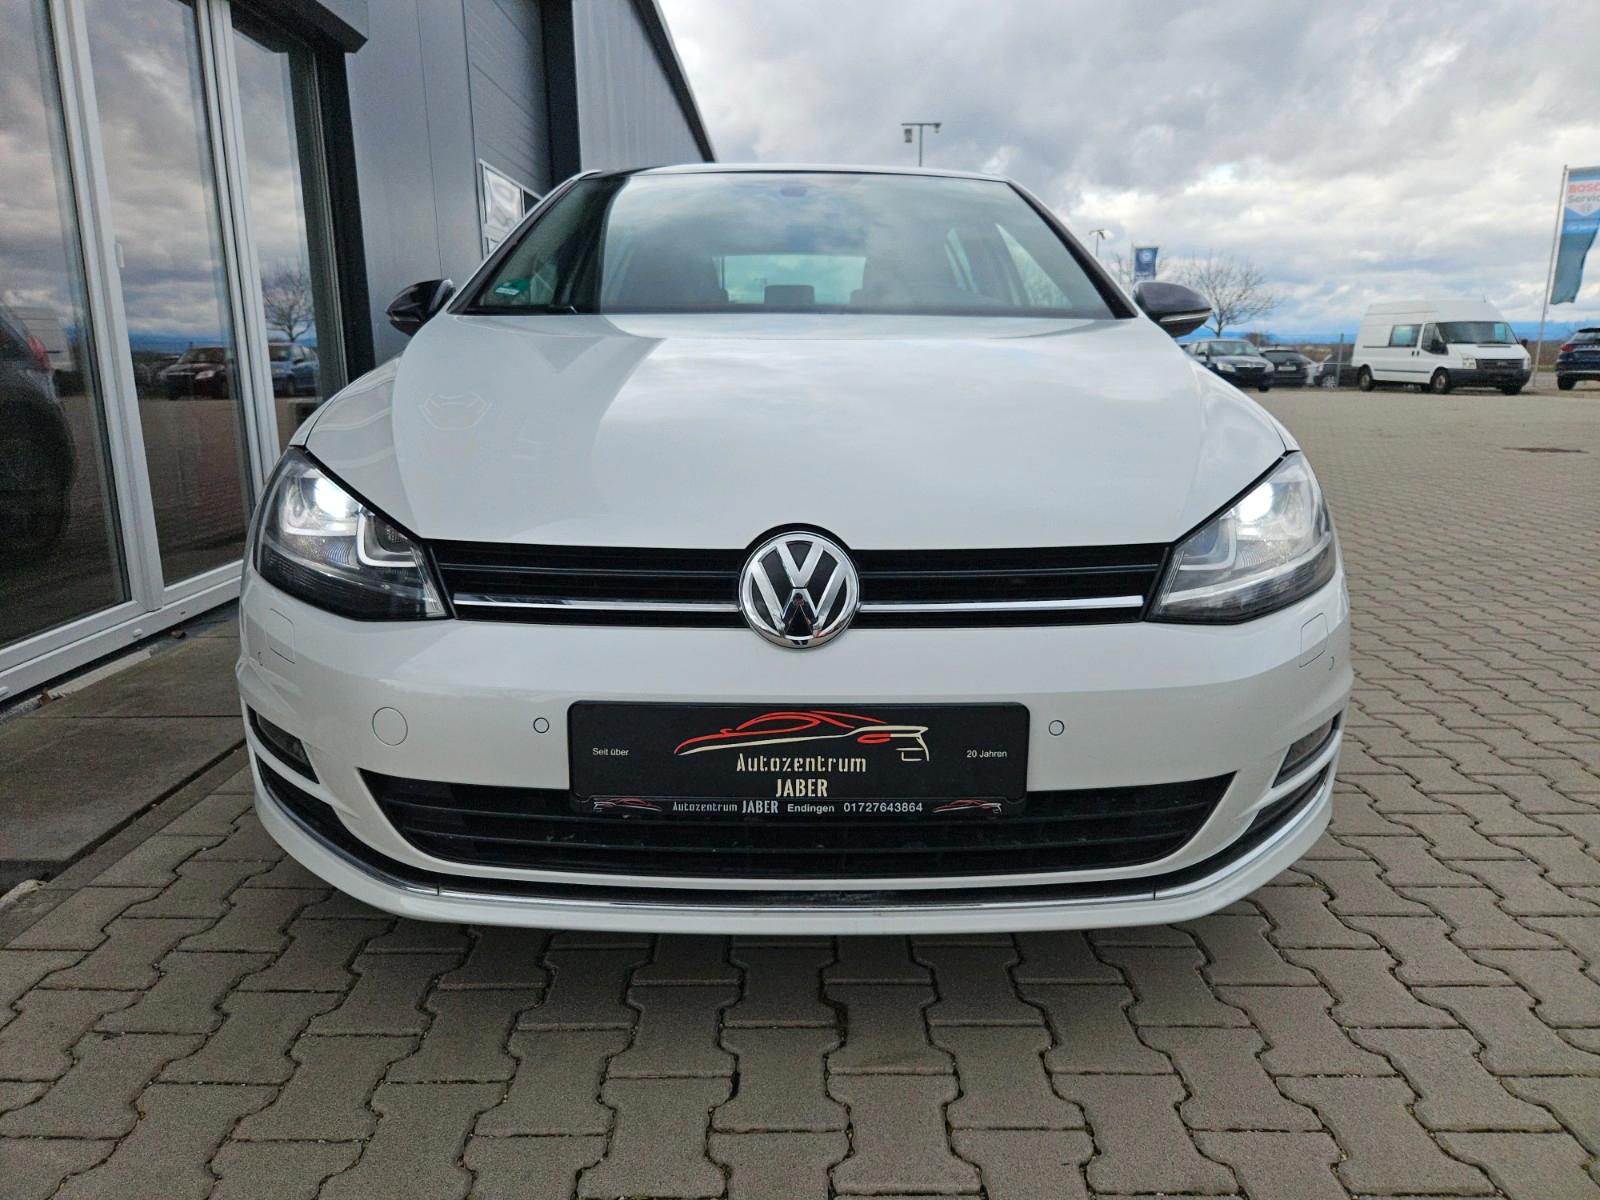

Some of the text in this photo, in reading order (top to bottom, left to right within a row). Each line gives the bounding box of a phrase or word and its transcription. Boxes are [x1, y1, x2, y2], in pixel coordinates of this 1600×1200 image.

[743, 534, 856, 643] VW
[592, 746, 629, 756] Seit über
[966, 748, 1008, 759] 20 Jahren
[736, 753, 867, 773] Autozentrum
[775, 778, 828, 798] JABER
[672, 800, 923, 815] Autozentrum JABER Endingen 01727643864
